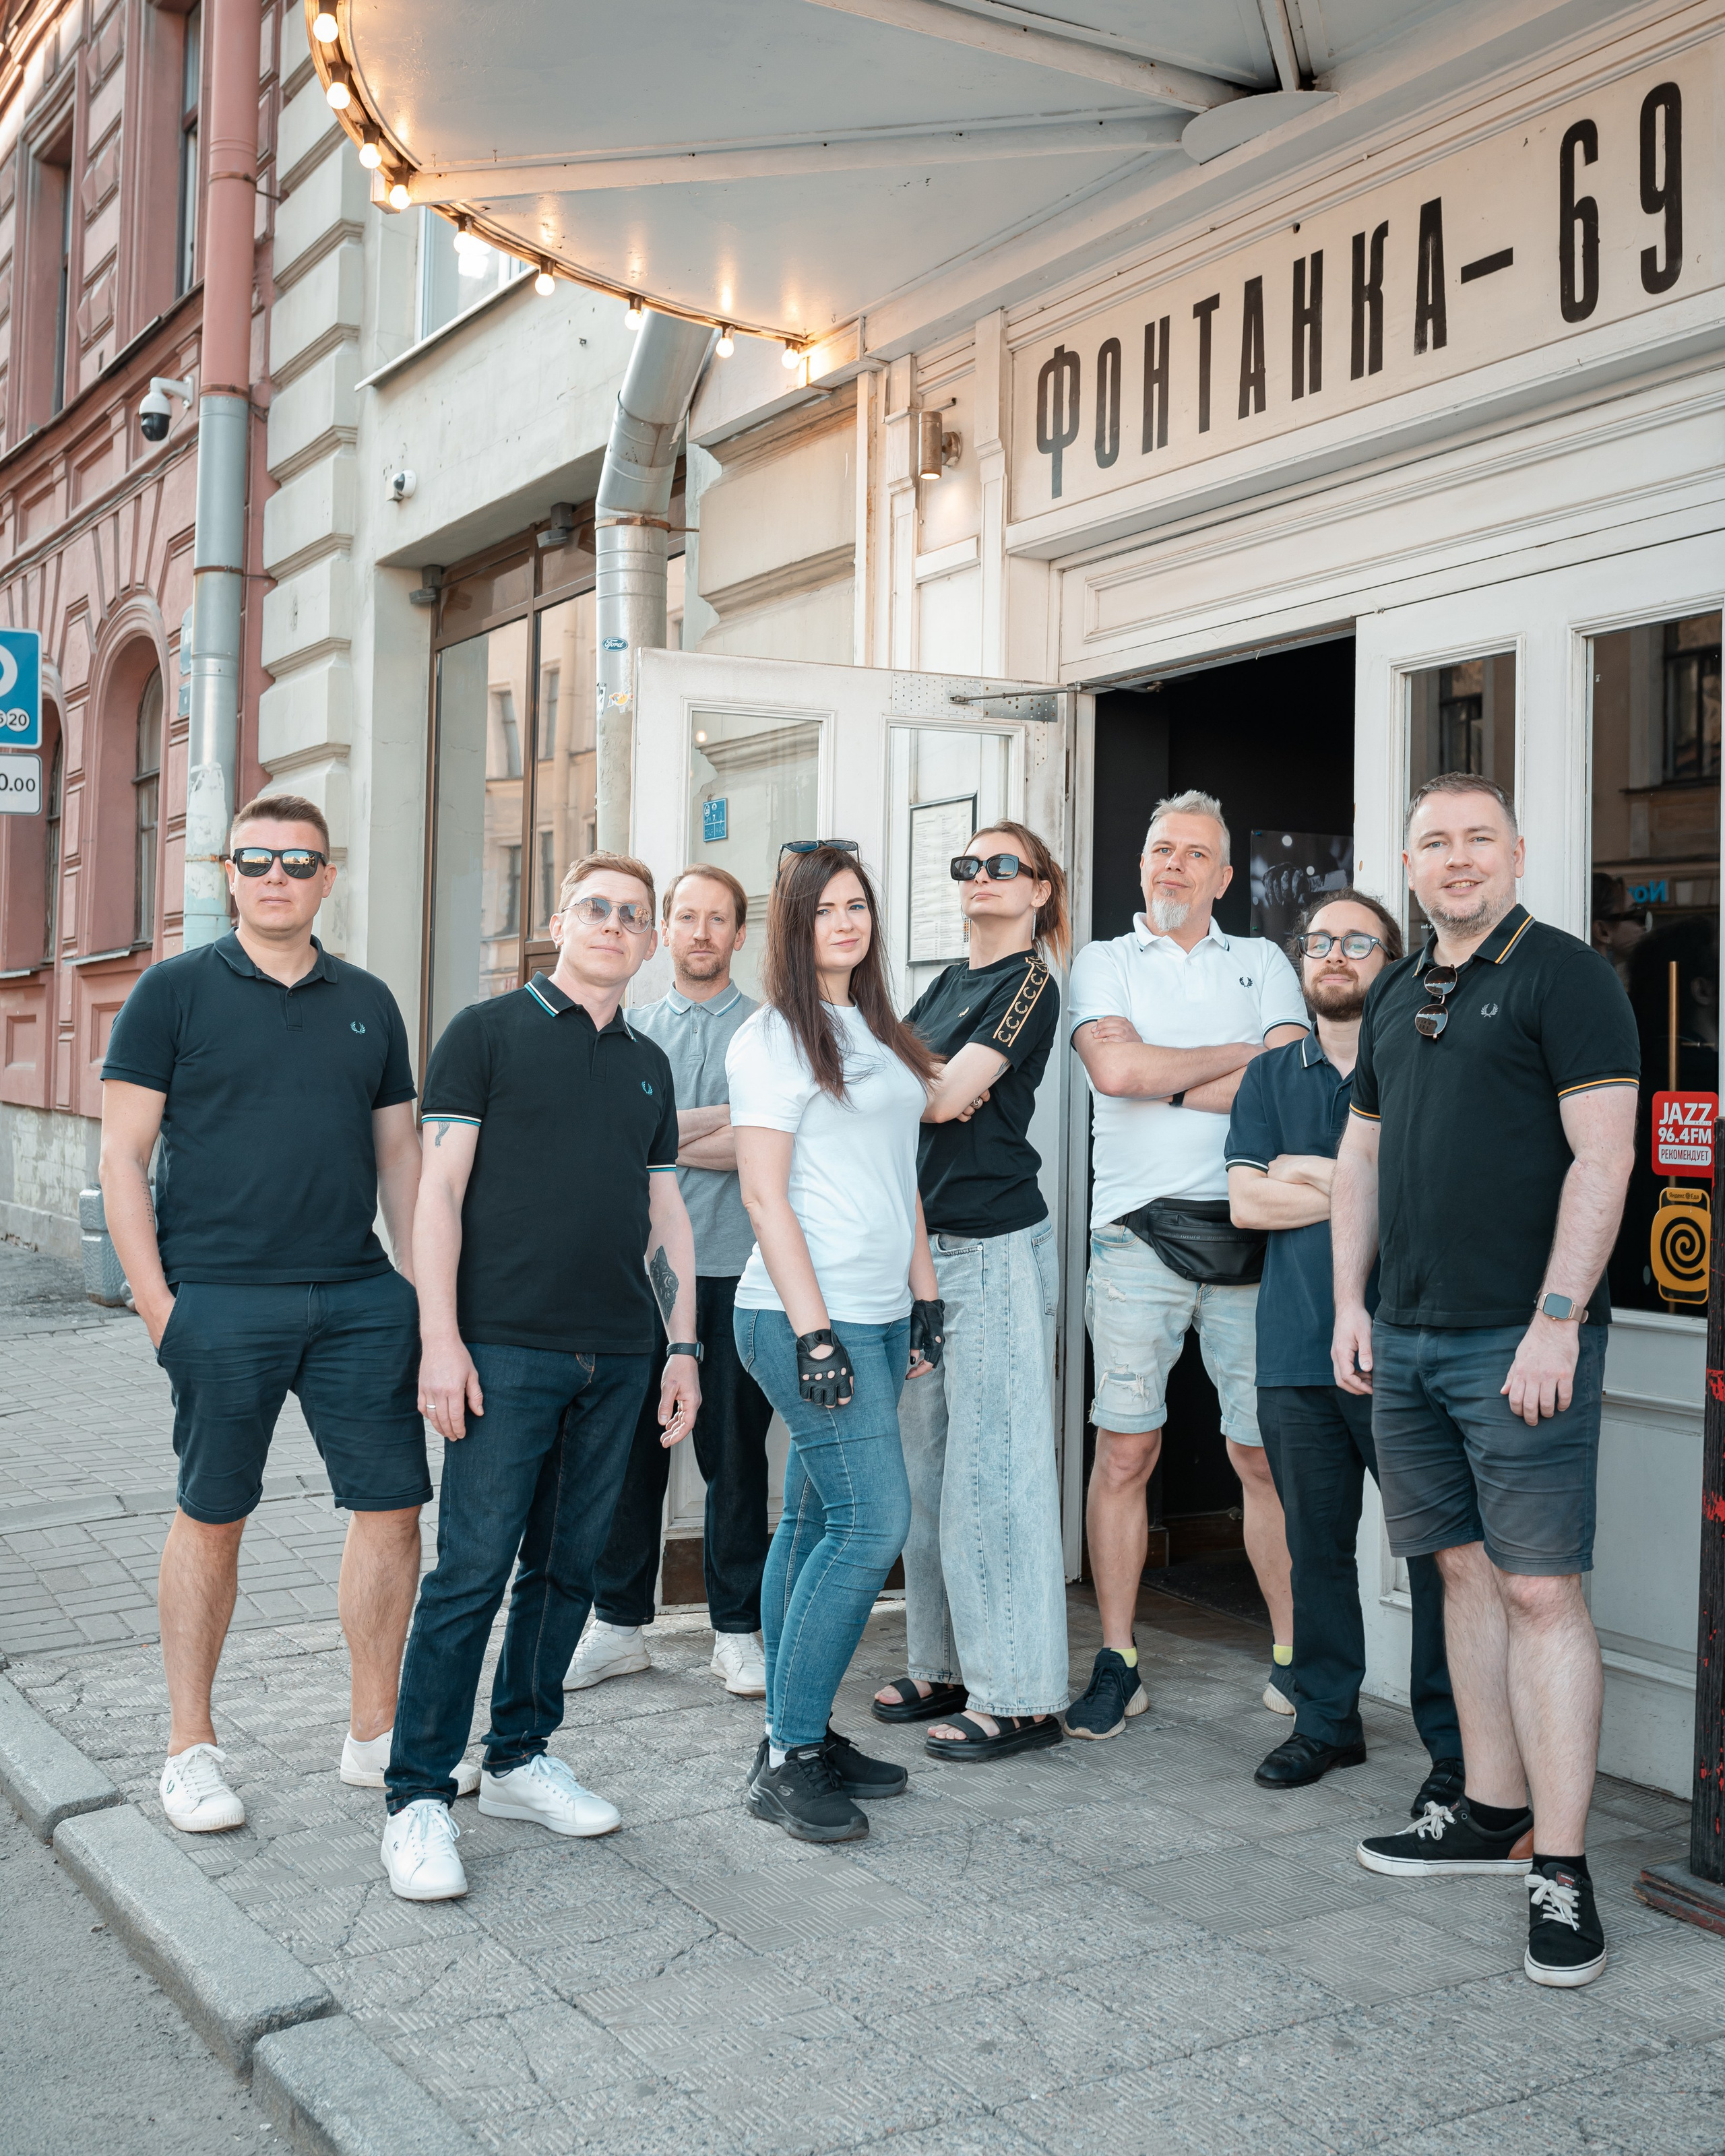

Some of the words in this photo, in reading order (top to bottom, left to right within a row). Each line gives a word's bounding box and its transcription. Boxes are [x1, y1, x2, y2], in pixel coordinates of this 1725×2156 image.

[604, 639, 624, 650] Ford
[9, 713, 27, 726] 20
[1659, 1102, 1712, 1126] JAZZ
[1661, 1149, 1709, 1162] РЕКОМЕНДУЕТ
